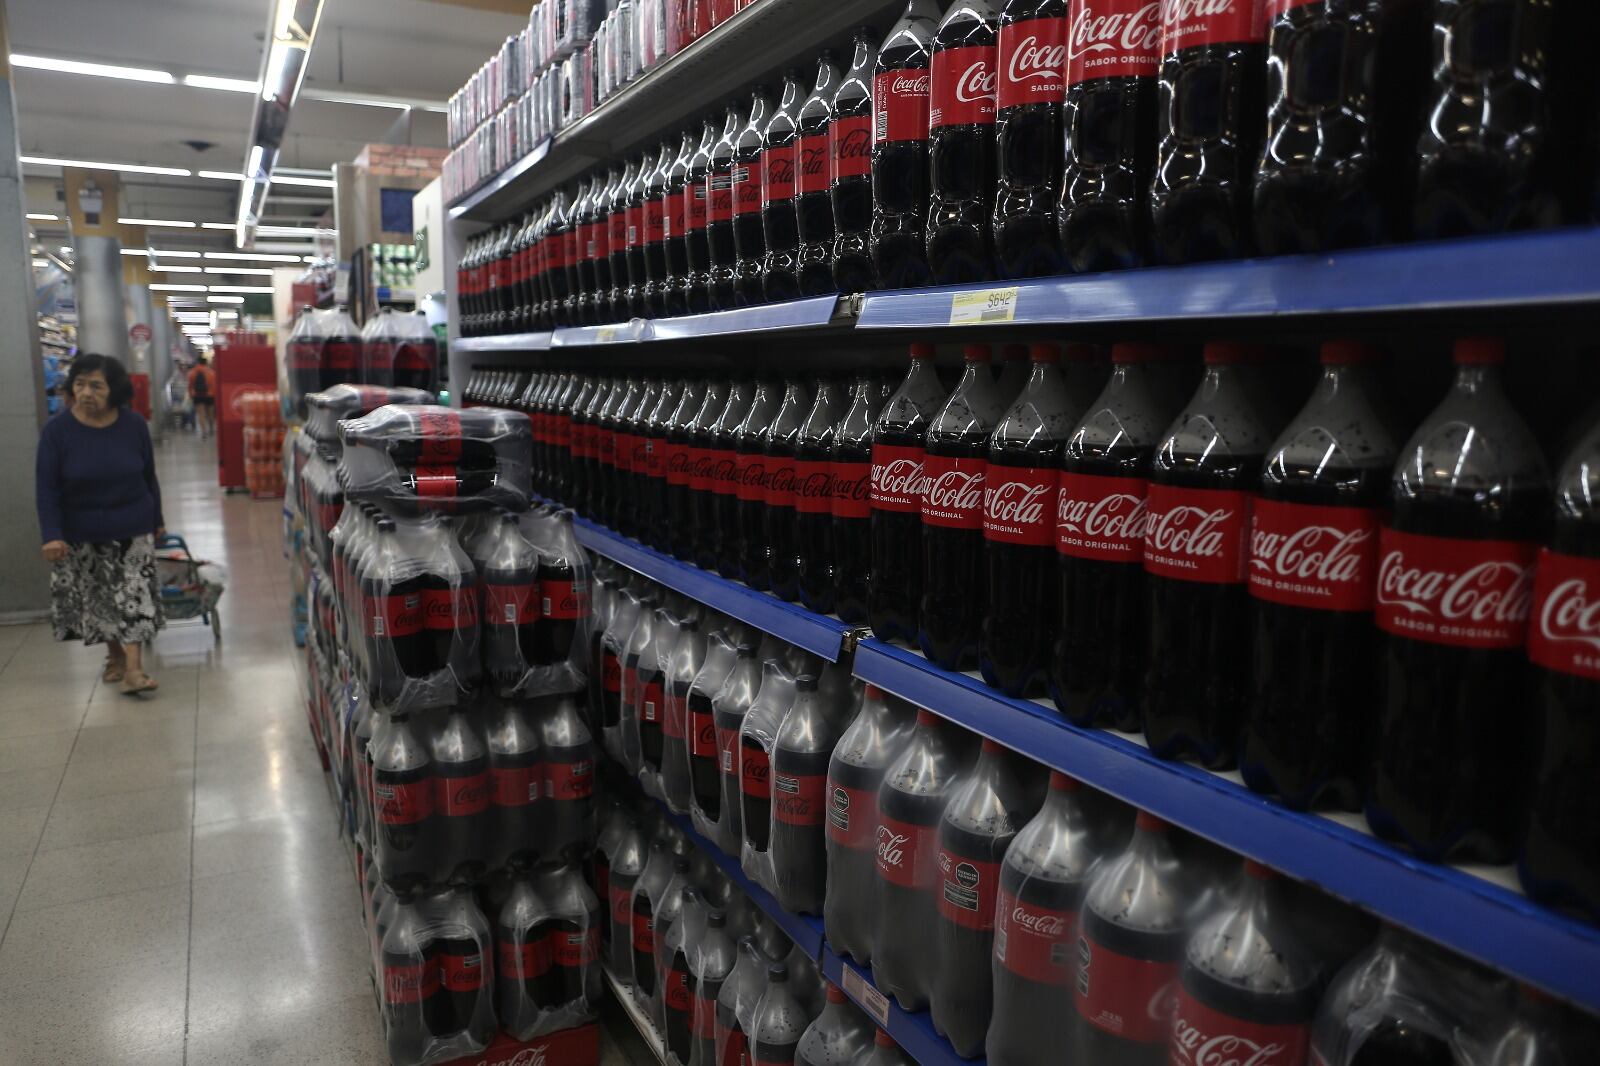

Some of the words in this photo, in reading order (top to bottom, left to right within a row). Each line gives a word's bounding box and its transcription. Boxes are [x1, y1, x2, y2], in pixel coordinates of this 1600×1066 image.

[1069, 2, 1160, 60] Coca-Co
[1085, 56, 1117, 67] SABOR
[880, 495, 911, 503] ORIGINAL
[931, 510, 963, 519] ORIGINAL
[991, 524, 1023, 534] ORIGINAL
[1061, 535, 1083, 545] SABOR
[1085, 540, 1132, 551] ORIGINAL
[1155, 555, 1198, 569] ORIGINAL
[1275, 581, 1332, 596] ORIGINAL
[1393, 616, 1435, 633] SABOR
[1439, 624, 1509, 639] ORIGINAL
